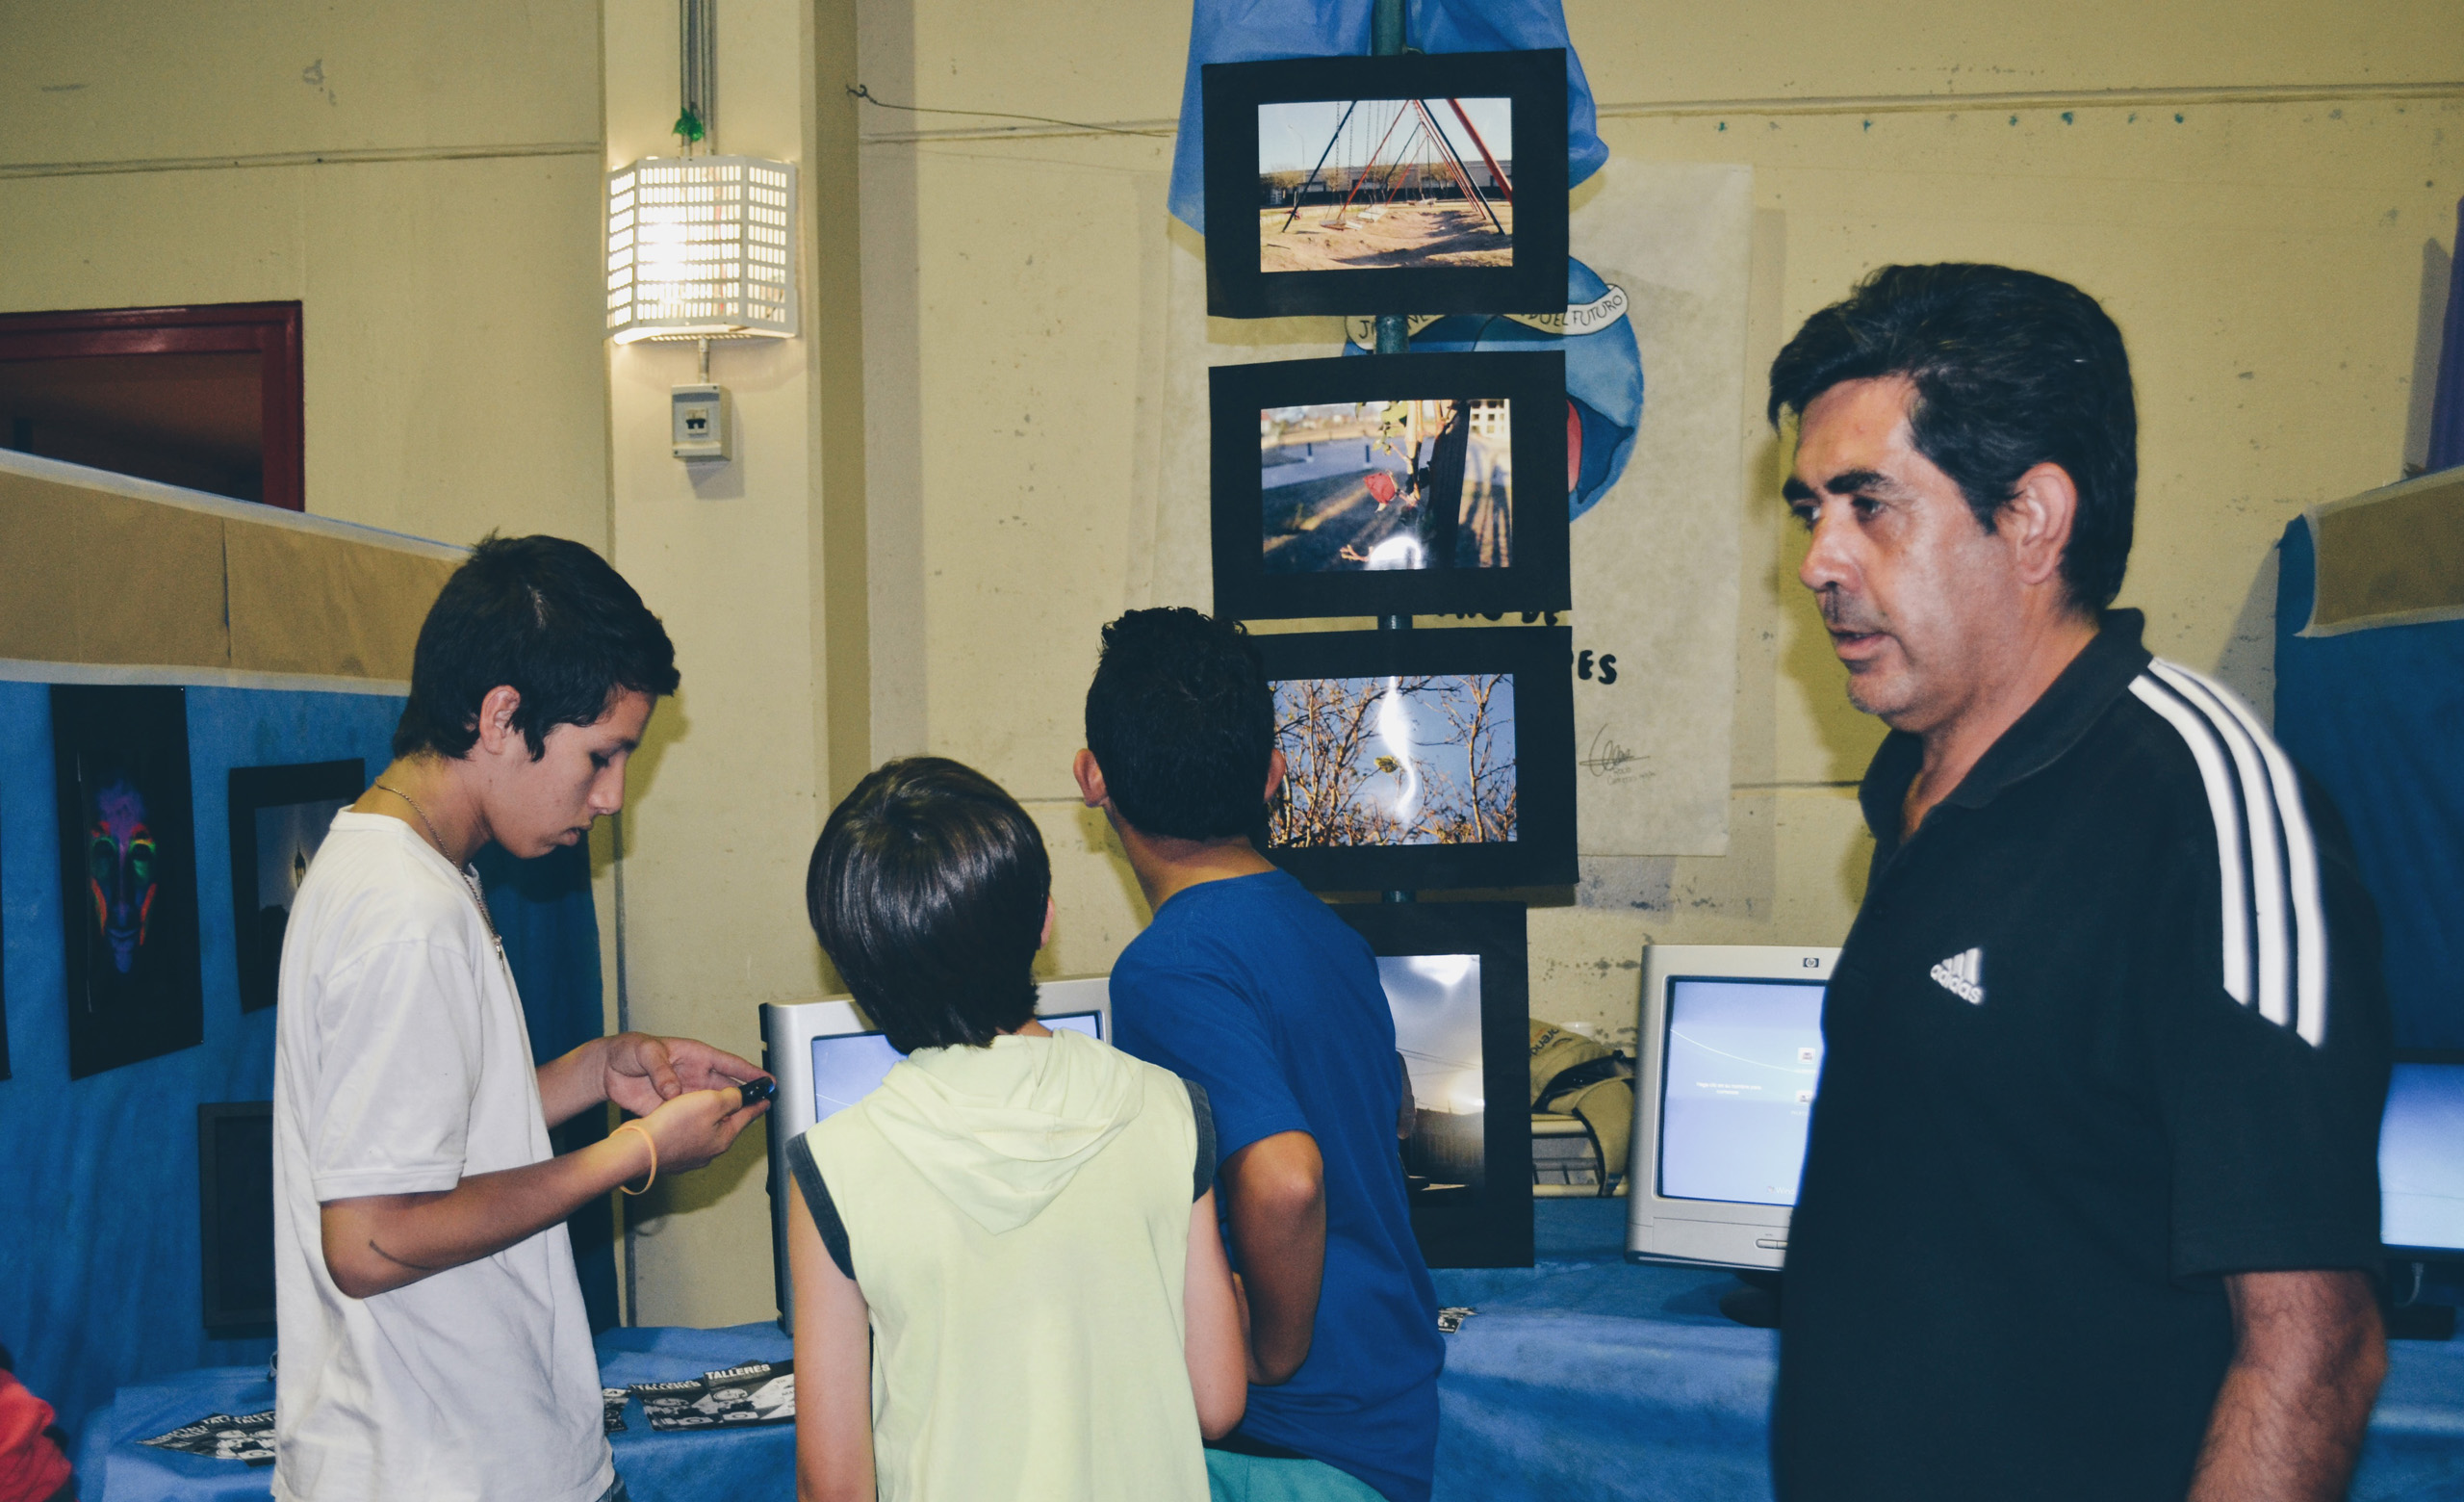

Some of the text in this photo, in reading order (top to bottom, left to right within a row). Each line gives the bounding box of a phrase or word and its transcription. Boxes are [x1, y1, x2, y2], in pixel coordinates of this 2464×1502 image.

[1572, 295, 1623, 326] FUTURO
[1575, 649, 1618, 686] ES
[705, 1364, 771, 1381] TALLERES
